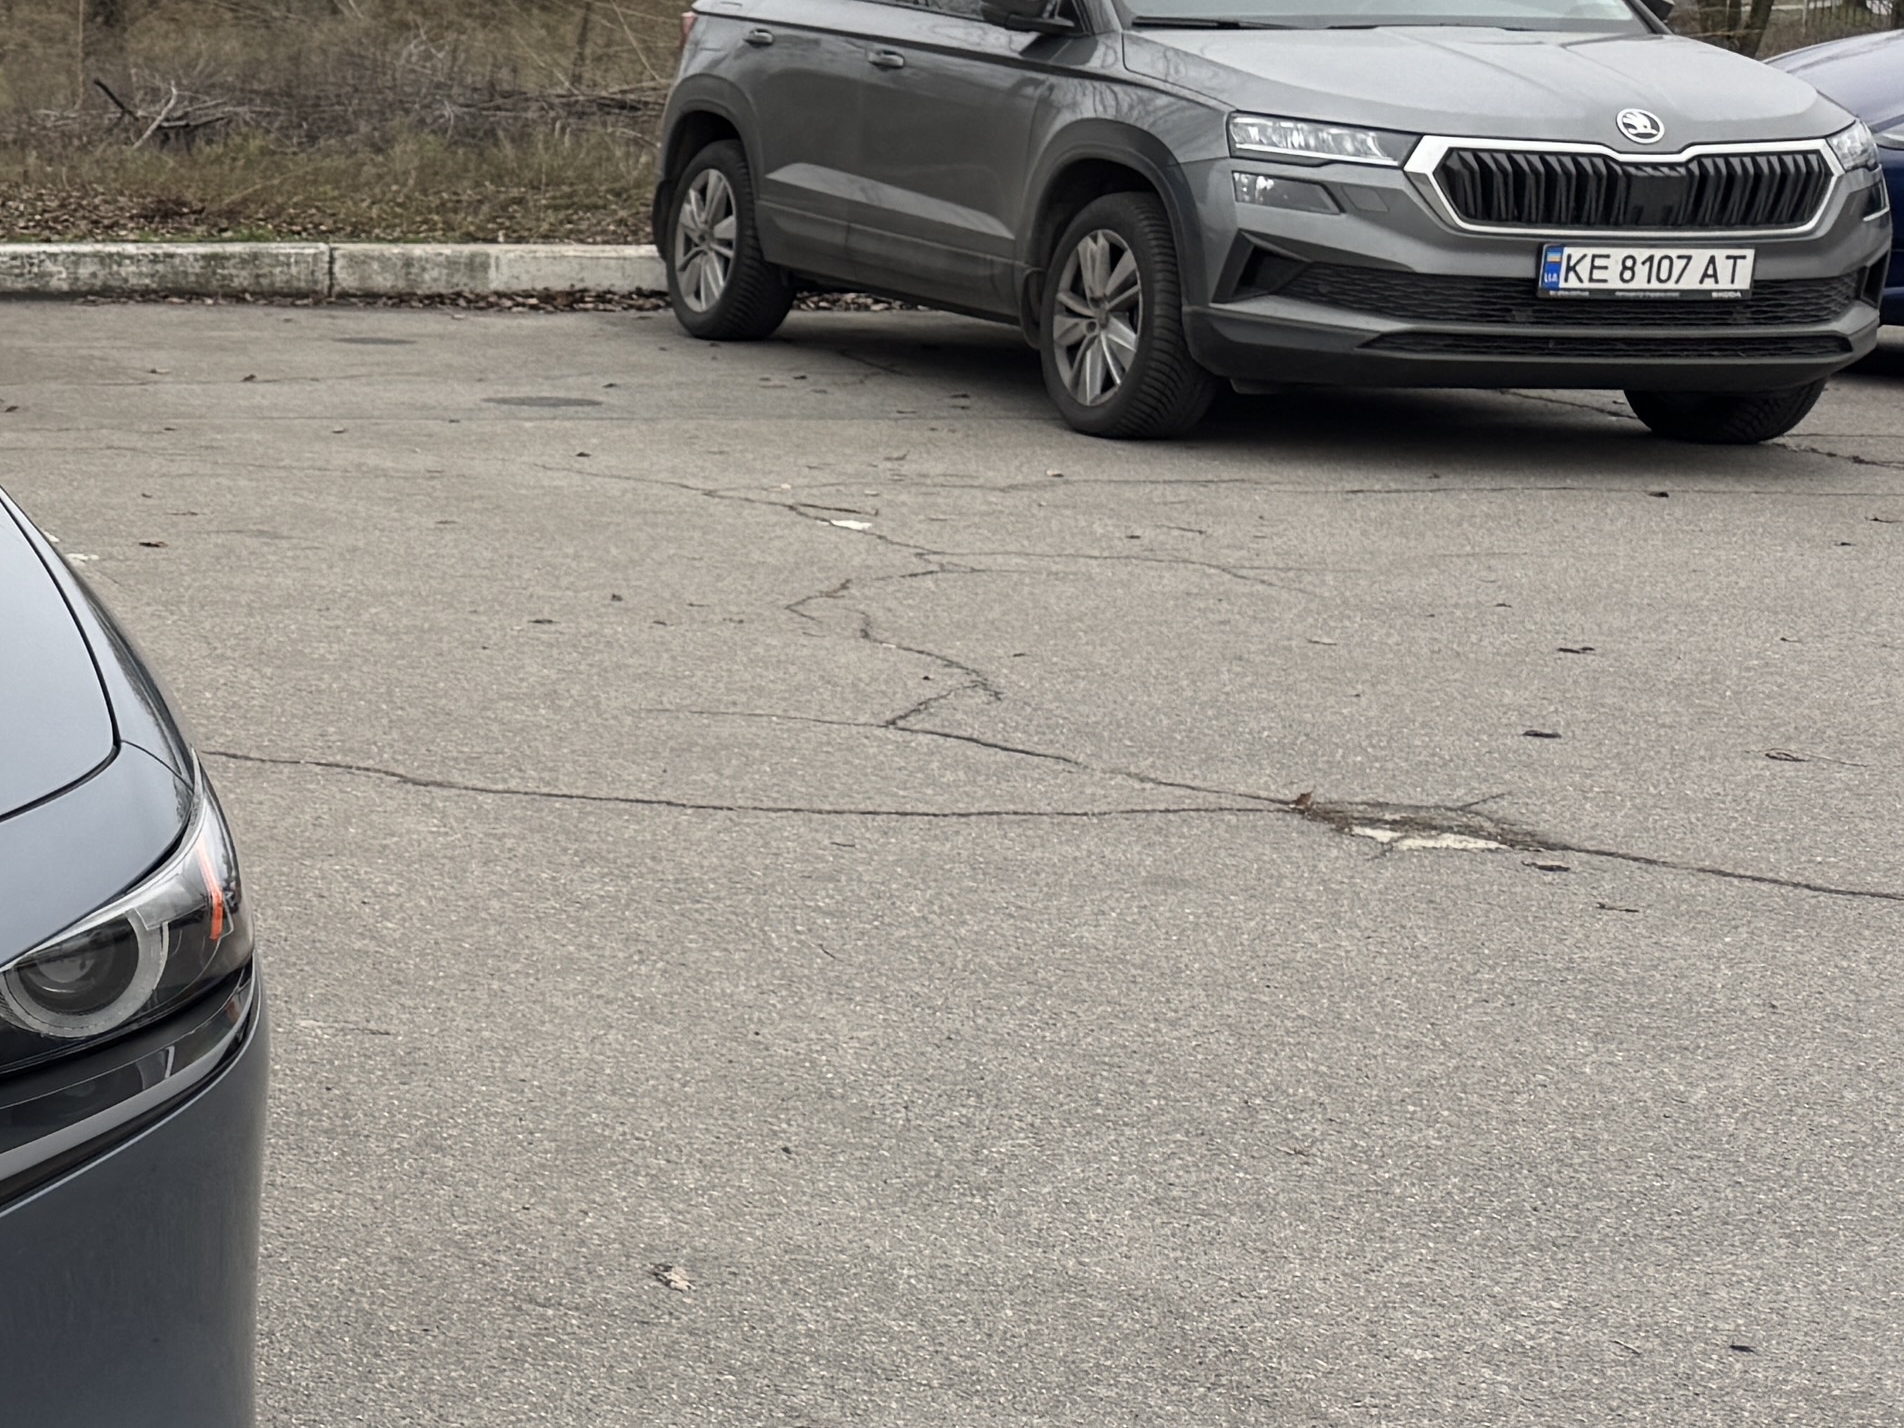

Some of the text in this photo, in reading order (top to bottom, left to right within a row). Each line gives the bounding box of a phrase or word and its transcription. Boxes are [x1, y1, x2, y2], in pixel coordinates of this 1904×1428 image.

[1563, 253, 1747, 284] KE 8107 AT
